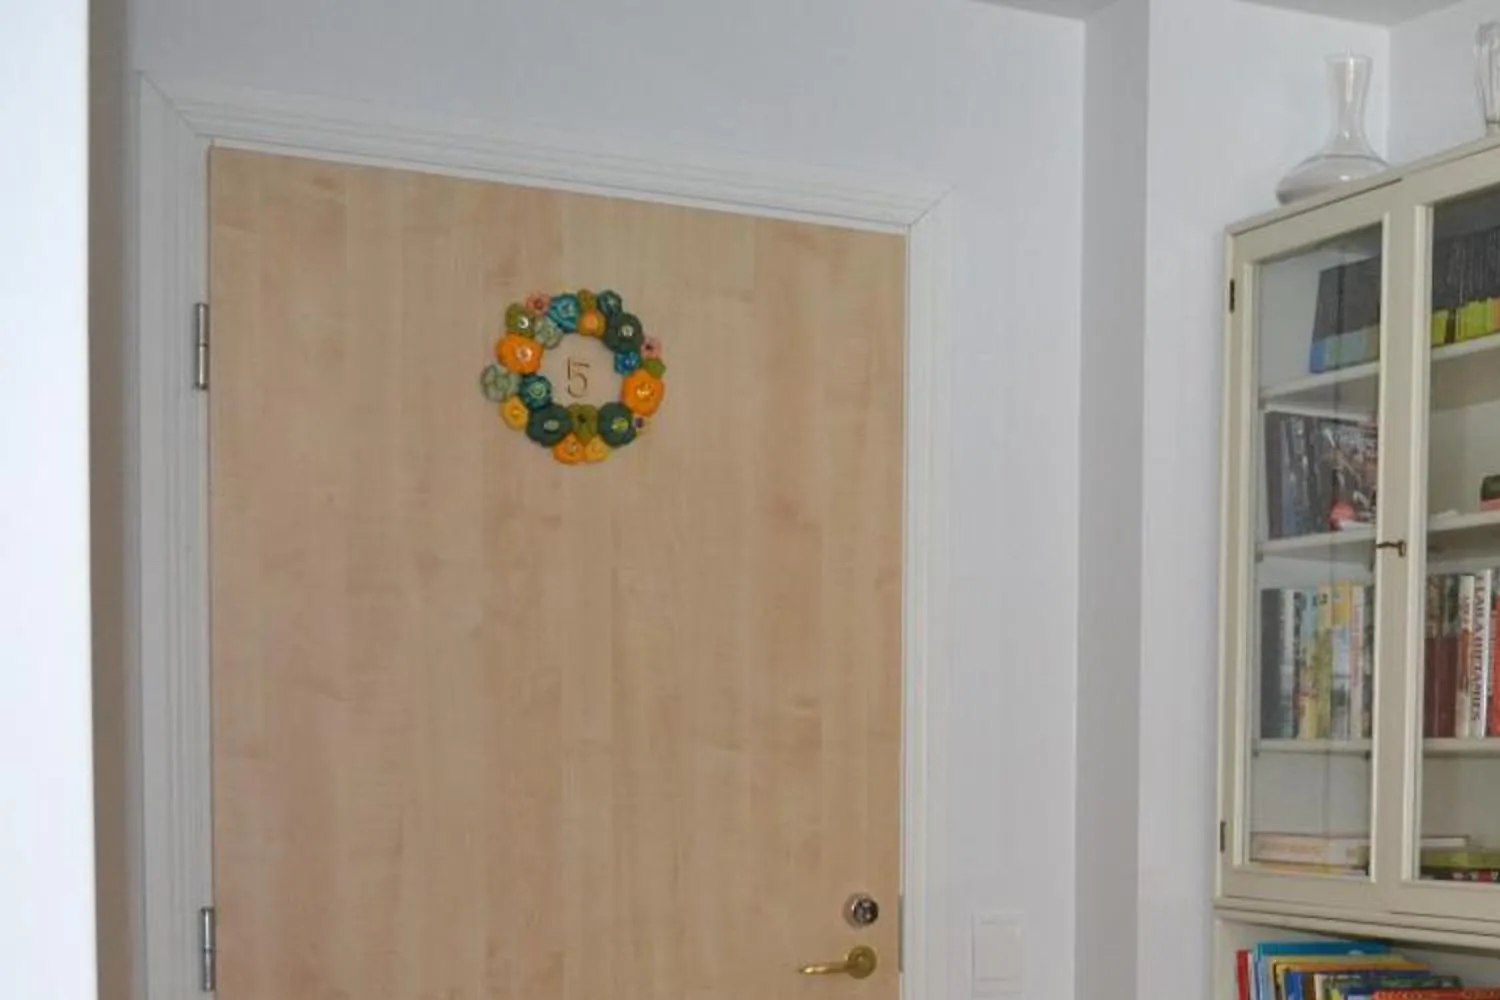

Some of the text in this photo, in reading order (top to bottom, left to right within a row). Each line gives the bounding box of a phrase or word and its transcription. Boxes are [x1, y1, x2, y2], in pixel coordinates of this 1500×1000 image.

[567, 357, 591, 398] 5
[1470, 586, 1487, 722] LAILA HIETAMIES
